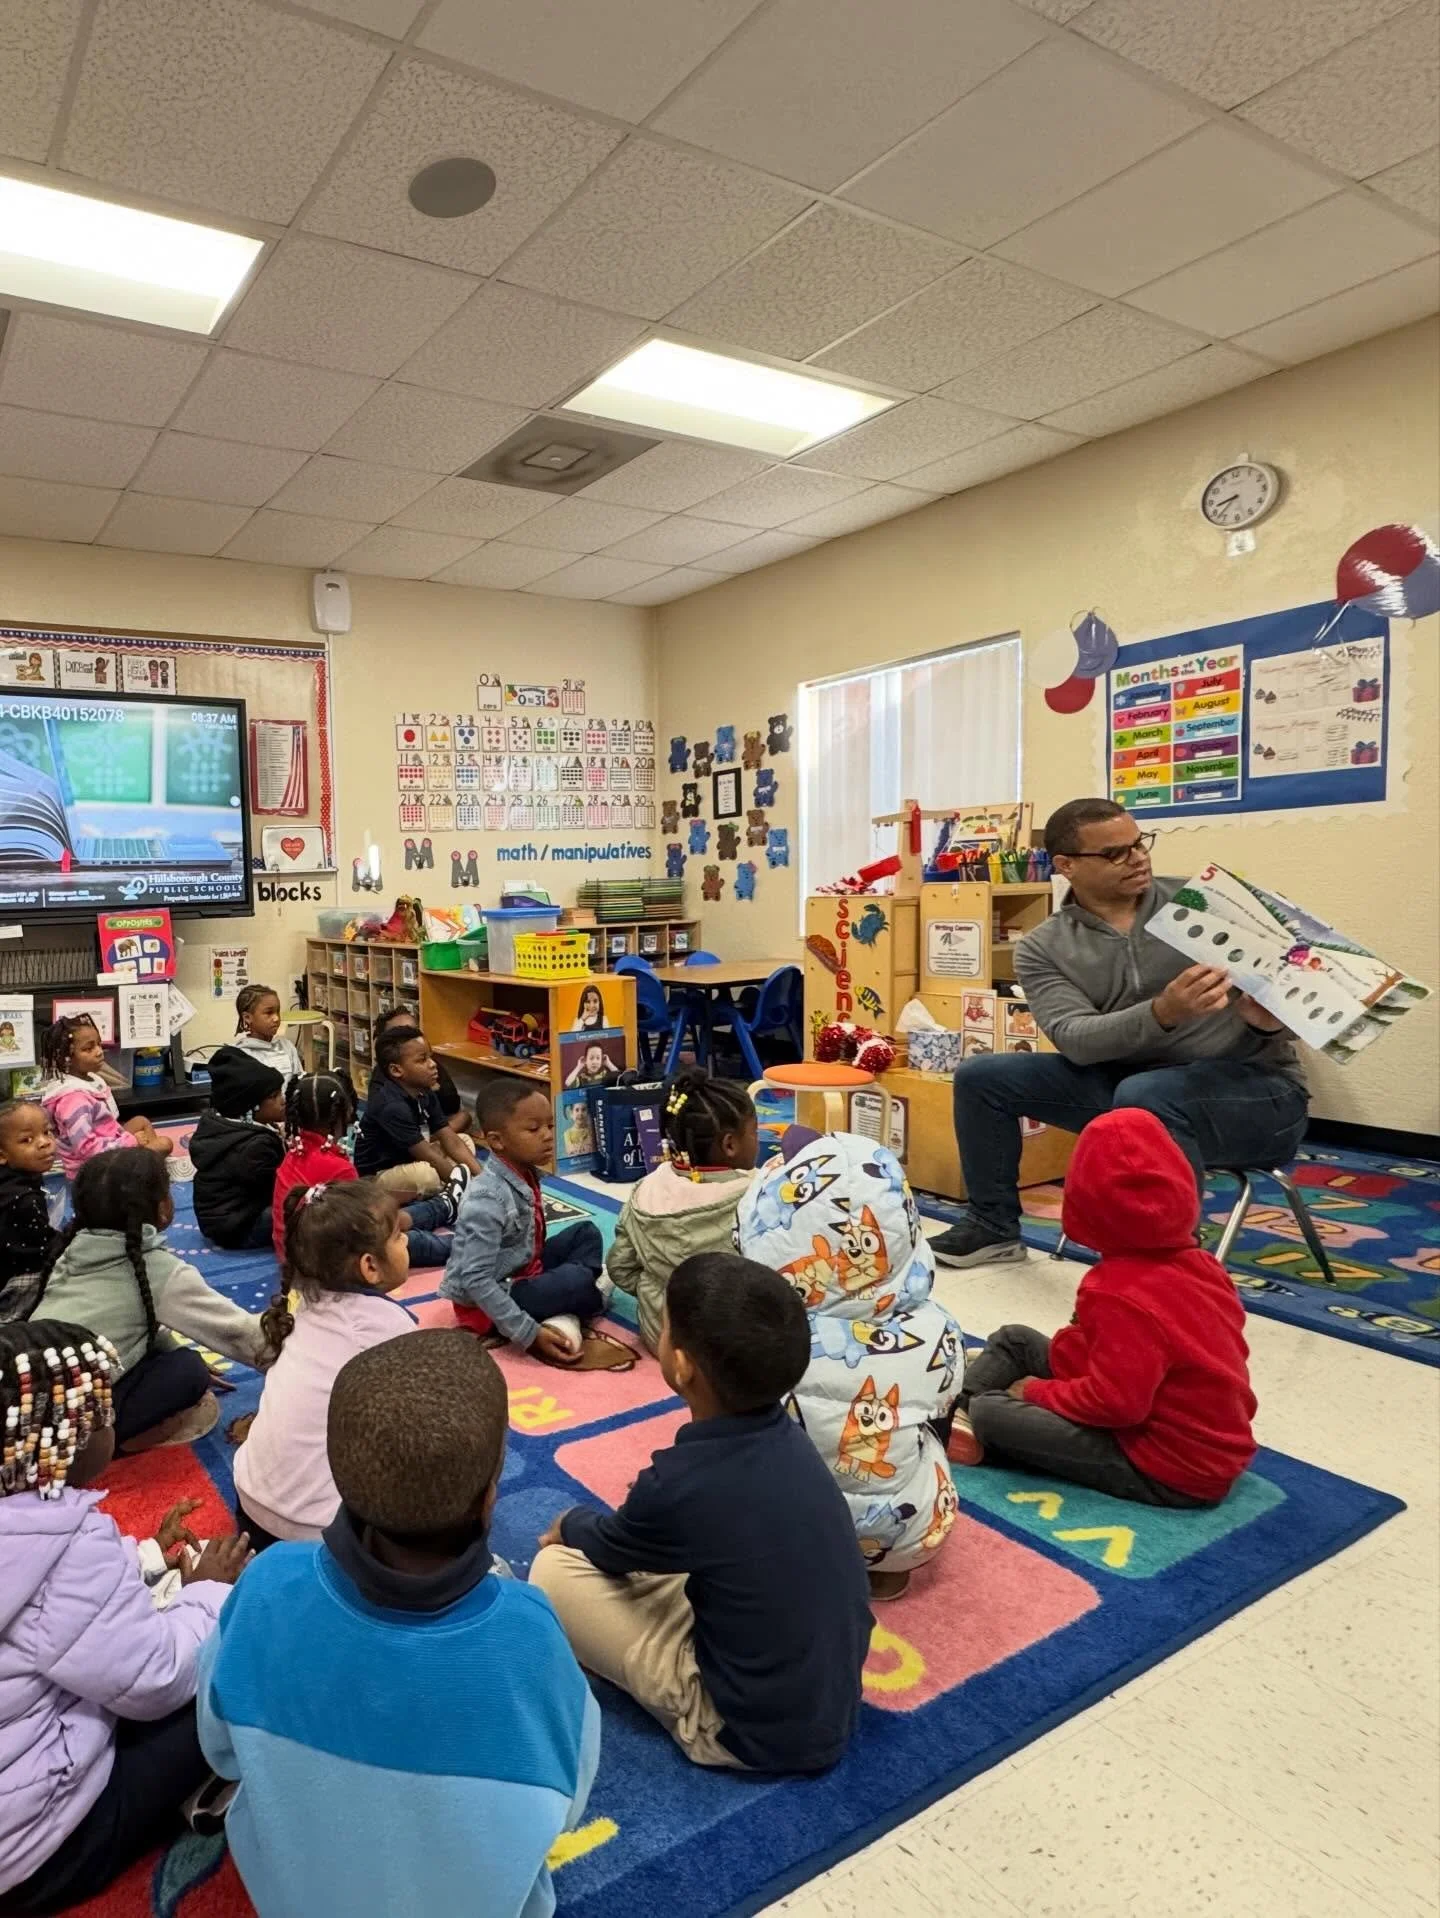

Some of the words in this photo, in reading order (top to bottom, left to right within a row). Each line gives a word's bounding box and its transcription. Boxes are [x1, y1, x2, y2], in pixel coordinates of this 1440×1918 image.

[1116, 664, 1180, 688] Months
[1182, 661, 1192, 669] of
[1195, 654, 1239, 672] Year
[480, 673, 489, 686] 0
[562, 679, 571, 691] 31
[1201, 677, 1222, 688] July
[1131, 686, 1168, 699] January
[535, 695, 546, 706] 31
[1193, 696, 1231, 710] August
[220, 713, 238, 724] AM
[1128, 707, 1169, 721] February
[635, 719, 644, 730] 10
[1186, 717, 1236, 733] September
[1132, 728, 1163, 740] March
[1136, 749, 1159, 760] April
[1186, 761, 1236, 774] November
[1136, 771, 1159, 781] May
[1186, 782, 1236, 794] December
[400, 793, 411, 806] 21
[429, 793, 442, 806] 22
[457, 793, 469, 806] 23
[485, 794, 497, 806] 24
[511, 794, 523, 807] 25
[537, 795, 548, 806] 26
[587, 795, 599, 806] 28
[1135, 790, 1159, 799] June
[562, 795, 573, 807] 27
[611, 795, 622, 807] 29
[635, 795, 647, 807] 30
[497, 842, 538, 861] math
[551, 841, 652, 863] manipulatives
[148, 873, 209, 883] Hillsborough
[210, 872, 244, 883] County
[1200, 866, 1218, 881] 5
[149, 886, 189, 894] PUBLIC
[257, 881, 322, 902] blocks
[116, 918, 153, 928] OPPOSITES
[623, 1132, 634, 1147] A
[623, 1149, 637, 1167] of
